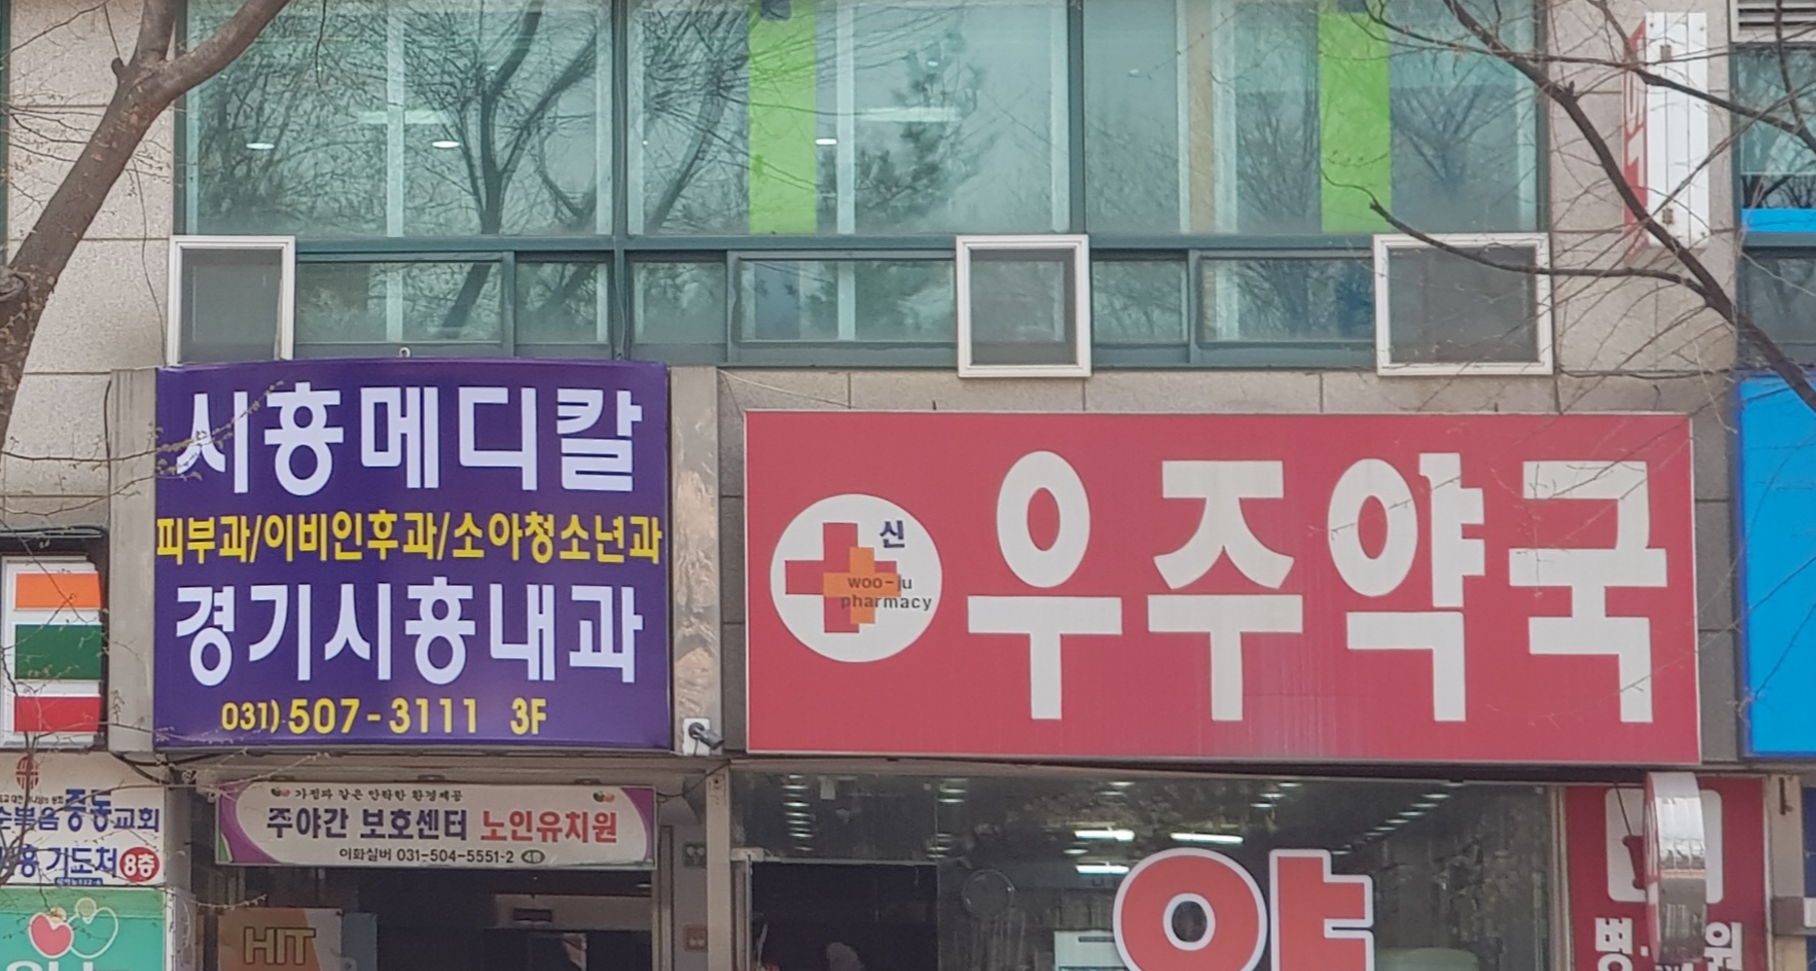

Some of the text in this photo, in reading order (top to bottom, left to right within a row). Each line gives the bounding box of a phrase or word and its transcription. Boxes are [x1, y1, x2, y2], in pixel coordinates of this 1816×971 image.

[176, 381, 644, 496] 시흥메디칼
[155, 508, 663, 565] 피부과/이비인후과/소아청소년과
[879, 519, 906, 549] 신
[840, 594, 933, 612] pharmacy
[967, 449, 1669, 723] 우주약국
[176, 575, 644, 687] 경기시흥내과
[510, 697, 548, 735] 3F
[266, 807, 619, 844] 주야간 보호센터 노인유치원
[46, 846, 118, 878] 기도처
[122, 854, 156, 878] 8층
[338, 847, 392, 862] 이화실버
[396, 848, 515, 864] 031-504-5551-2
[243, 926, 317, 966] HIT
